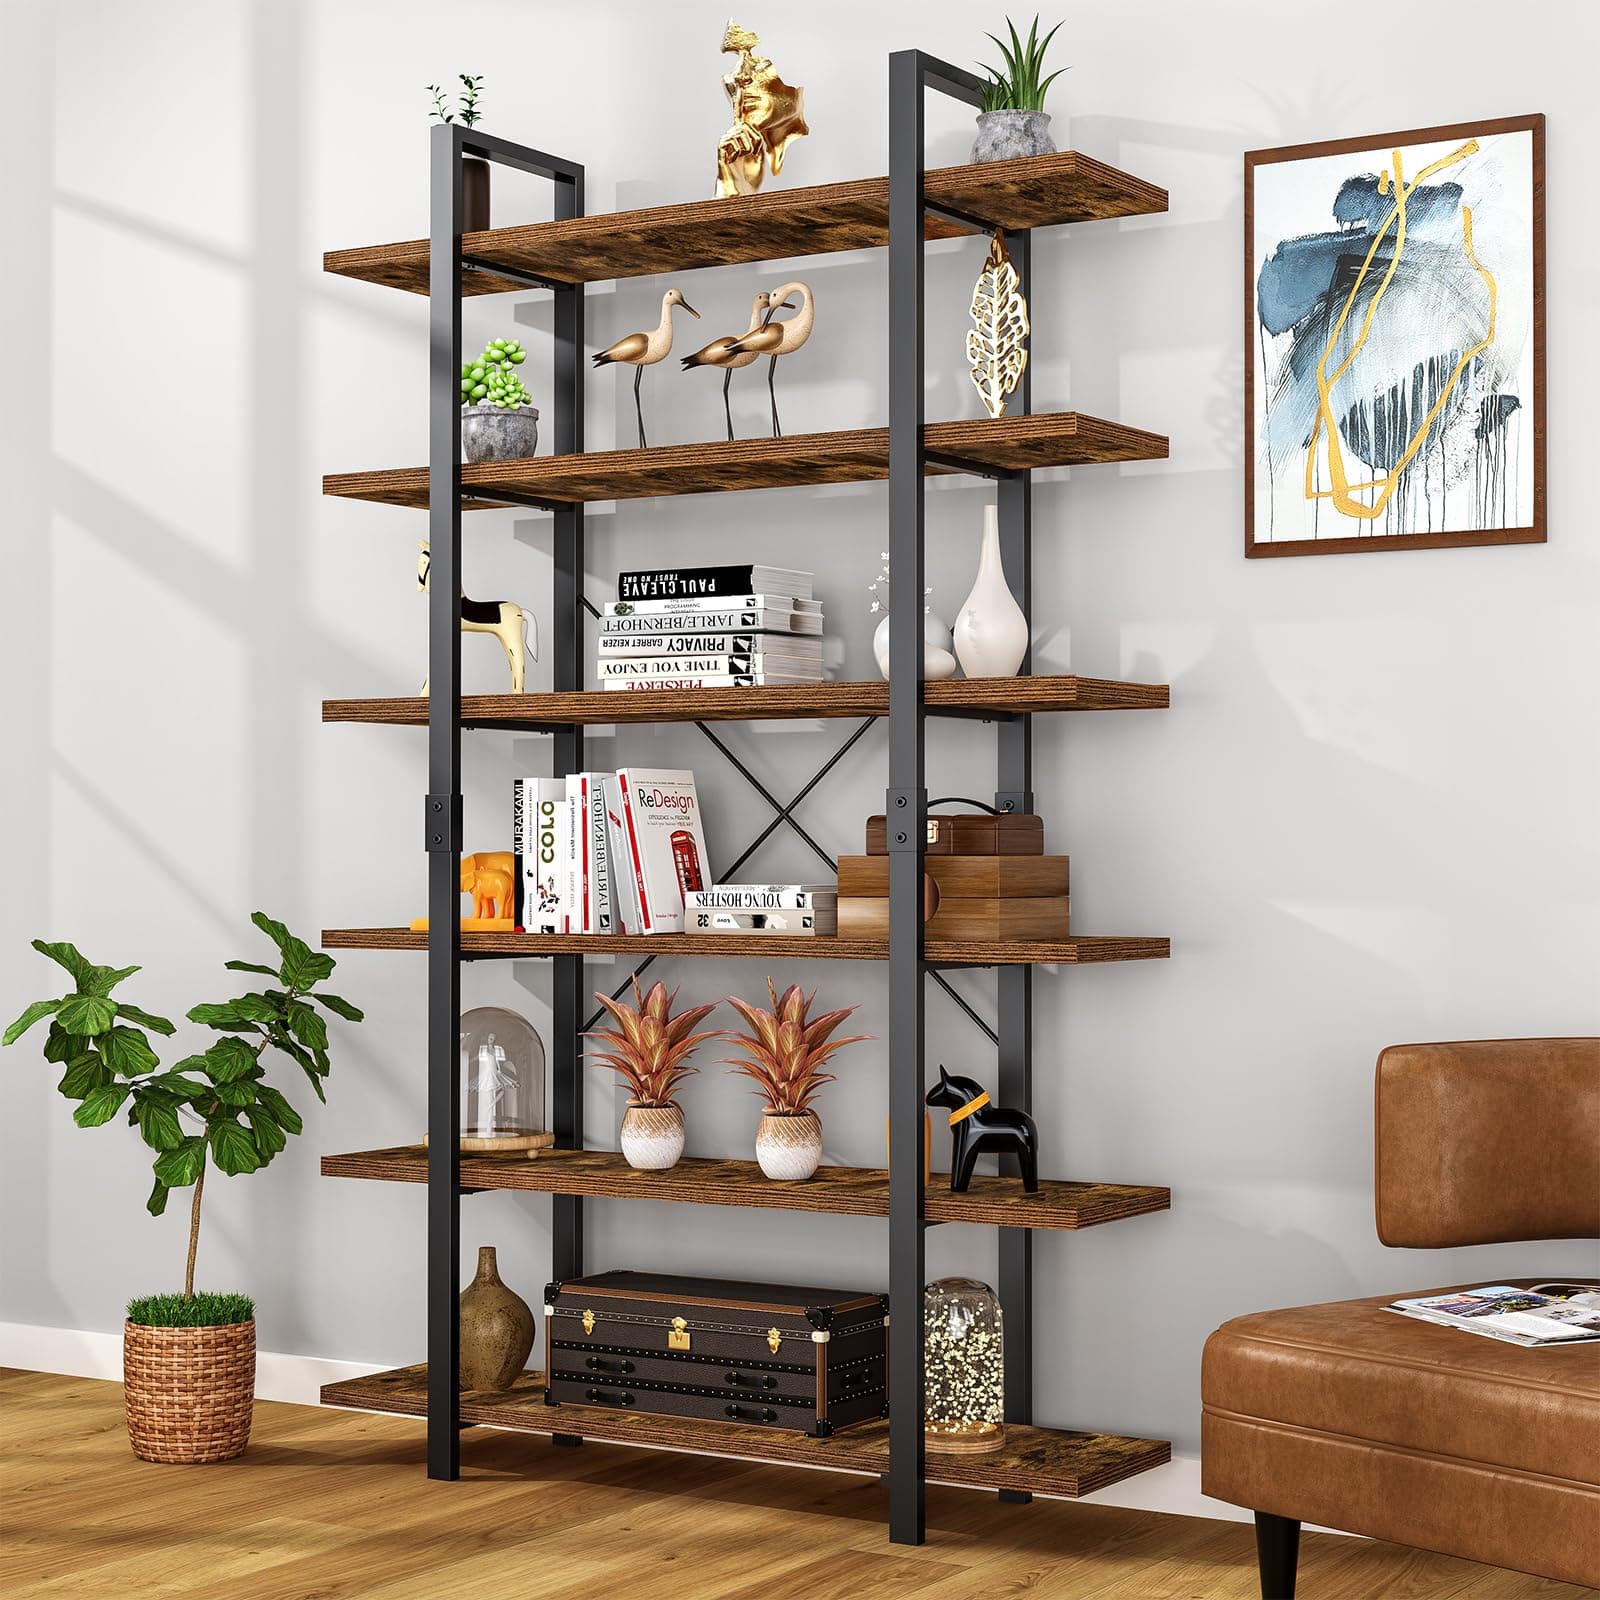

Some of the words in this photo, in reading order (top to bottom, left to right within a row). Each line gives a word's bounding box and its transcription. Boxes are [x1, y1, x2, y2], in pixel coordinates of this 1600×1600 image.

[655, 573, 678, 582] TRUST
[623, 581, 676, 596] CLEAVE
[680, 578, 716, 593] PAUL
[604, 614, 734, 632] JARLE/BERNHOFT
[602, 639, 631, 648] KEIZER
[632, 639, 663, 648] GARRET
[667, 638, 725, 652] PRIVACY
[604, 663, 648, 675] ENJOY
[652, 661, 681, 673] YOU
[683, 660, 720, 672] TIME
[638, 788, 694, 814] ReDesign
[514, 784, 524, 855] MURAKAMI
[695, 892, 742, 908] HOSTERS
[745, 893, 782, 908] YOUNG
[697, 914, 709, 927] 32
